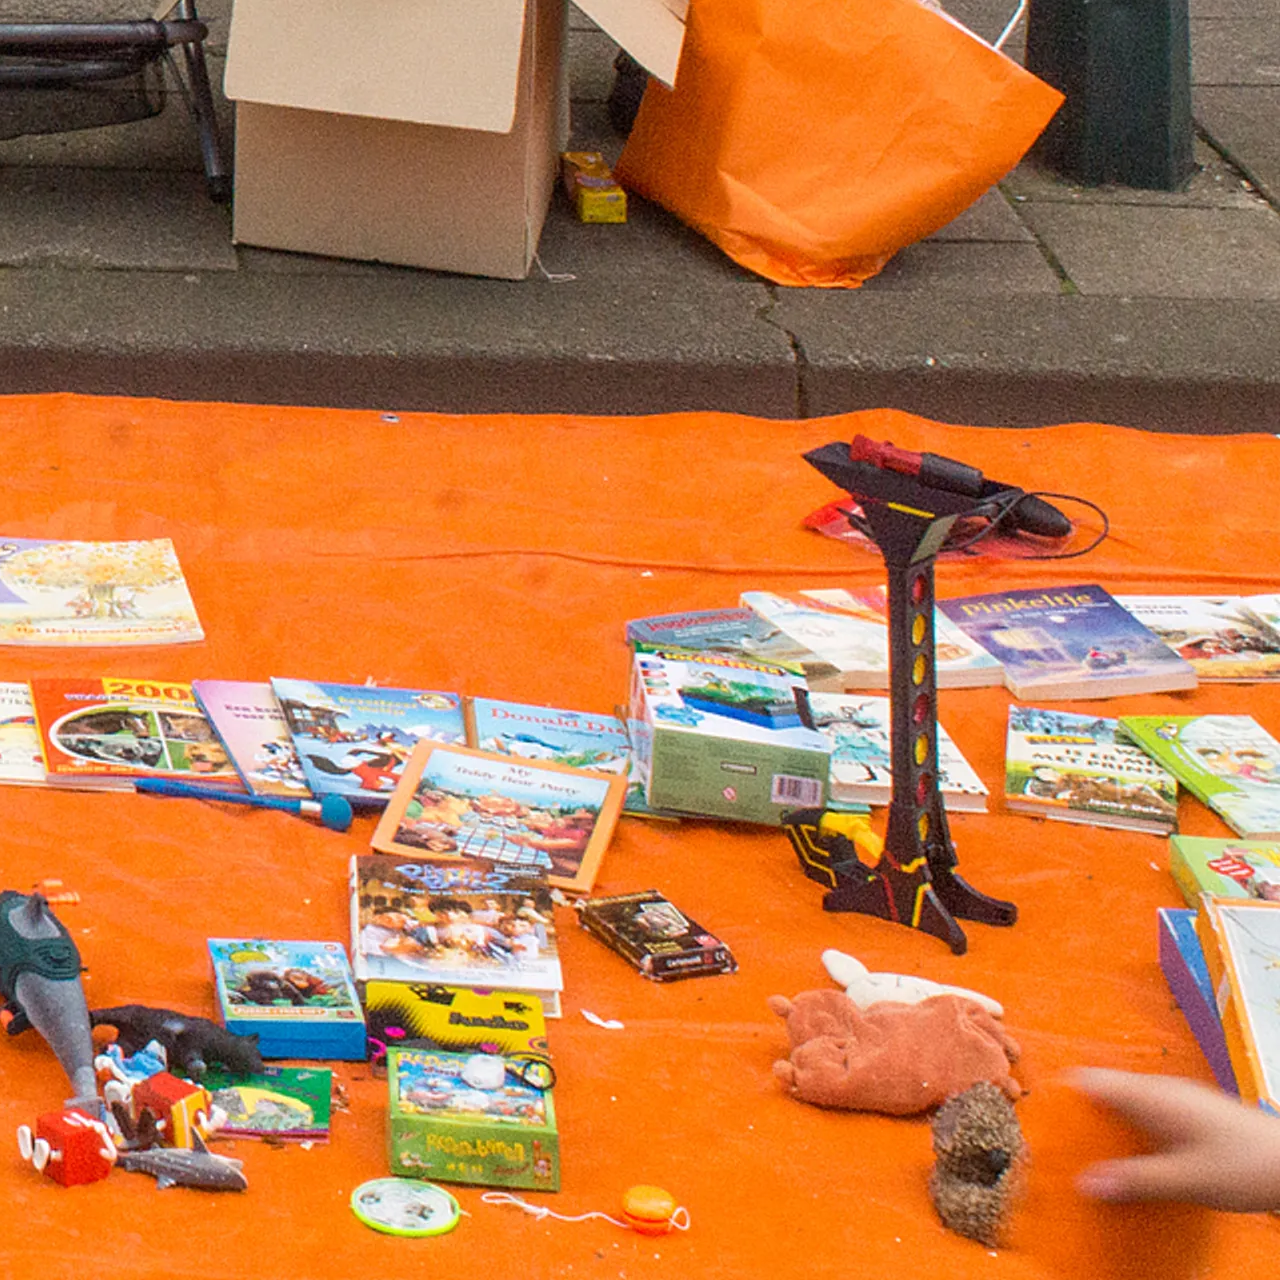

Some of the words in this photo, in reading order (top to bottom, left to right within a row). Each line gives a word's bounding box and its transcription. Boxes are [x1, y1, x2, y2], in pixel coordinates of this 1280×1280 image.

[960, 592, 1092, 618] Pinkeltje
[491, 707, 580, 729] Donald
[454, 765, 497, 780] Teddy
[540, 782, 583, 798] Party
